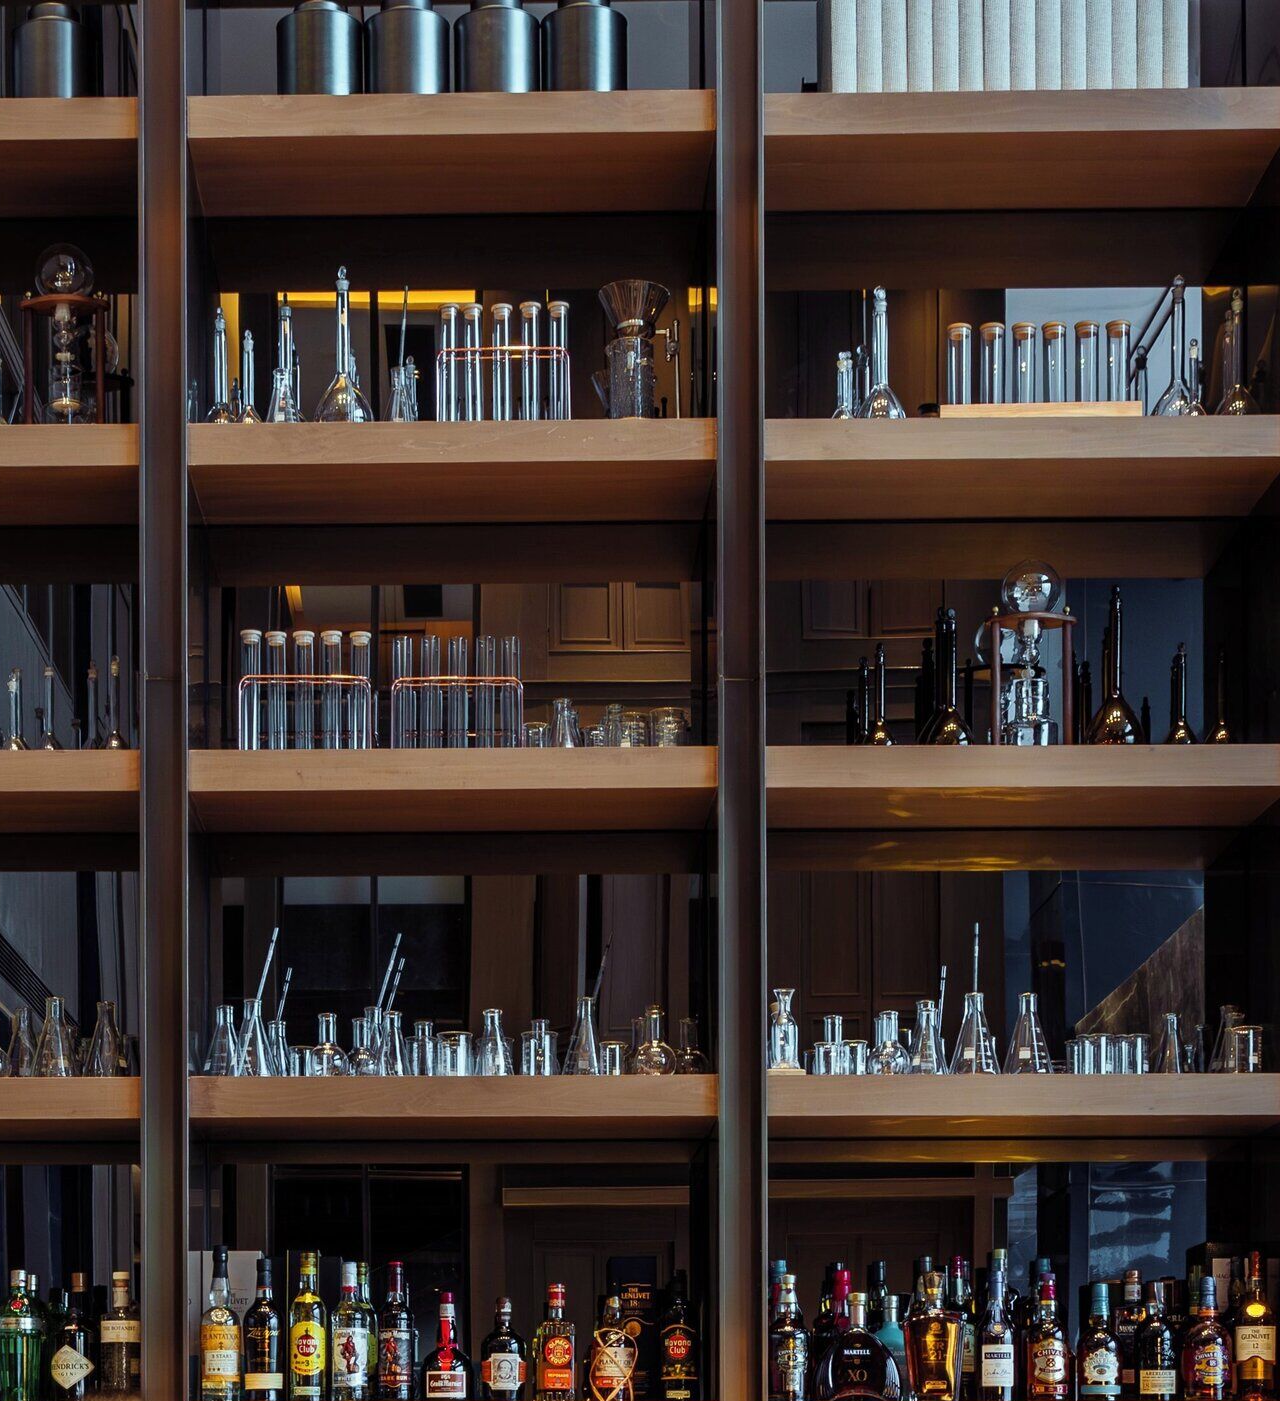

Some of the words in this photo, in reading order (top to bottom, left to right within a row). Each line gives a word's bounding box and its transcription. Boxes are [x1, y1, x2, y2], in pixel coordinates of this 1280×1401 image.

[621, 1292, 651, 1300] LENLIVET
[548, 1339, 570, 1349] OLMECA
[665, 1338, 691, 1346] Havana
[299, 1345, 316, 1353] Club
[669, 1346, 687, 1354] Club
[1037, 1349, 1063, 1357] CHIVAS
[548, 1354, 570, 1364] TEQUILA
[929, 1350, 942, 1360] 21
[304, 1359, 311, 1367] 3
[674, 1364, 681, 1373] 7
[847, 1369, 868, 1382] XO
